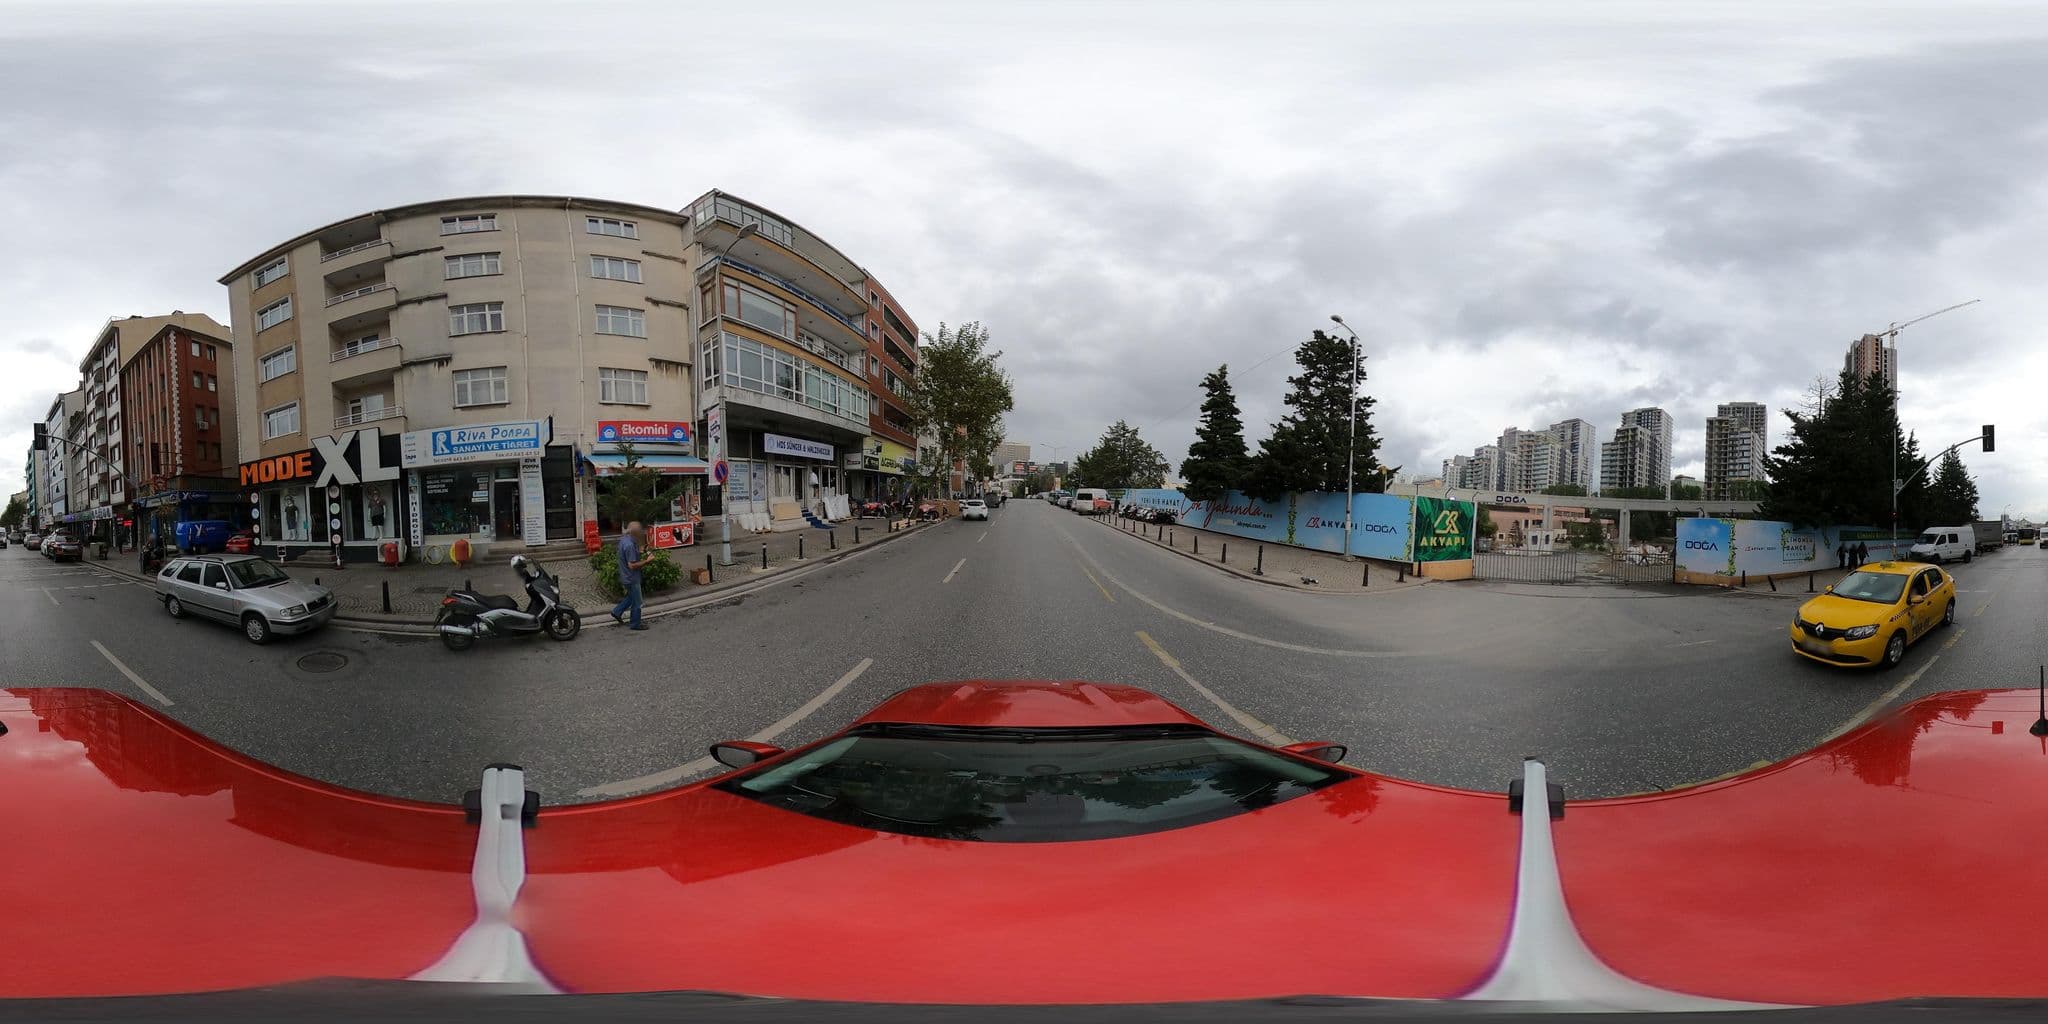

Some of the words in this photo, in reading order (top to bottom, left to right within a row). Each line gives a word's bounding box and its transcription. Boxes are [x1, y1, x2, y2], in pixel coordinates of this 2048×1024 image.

[621, 424, 668, 435] Ekomini
[486, 442, 499, 451] VE
[240, 452, 312, 486] MODE
[311, 427, 400, 488] XL
[1420, 536, 1465, 546] AKYAPI
